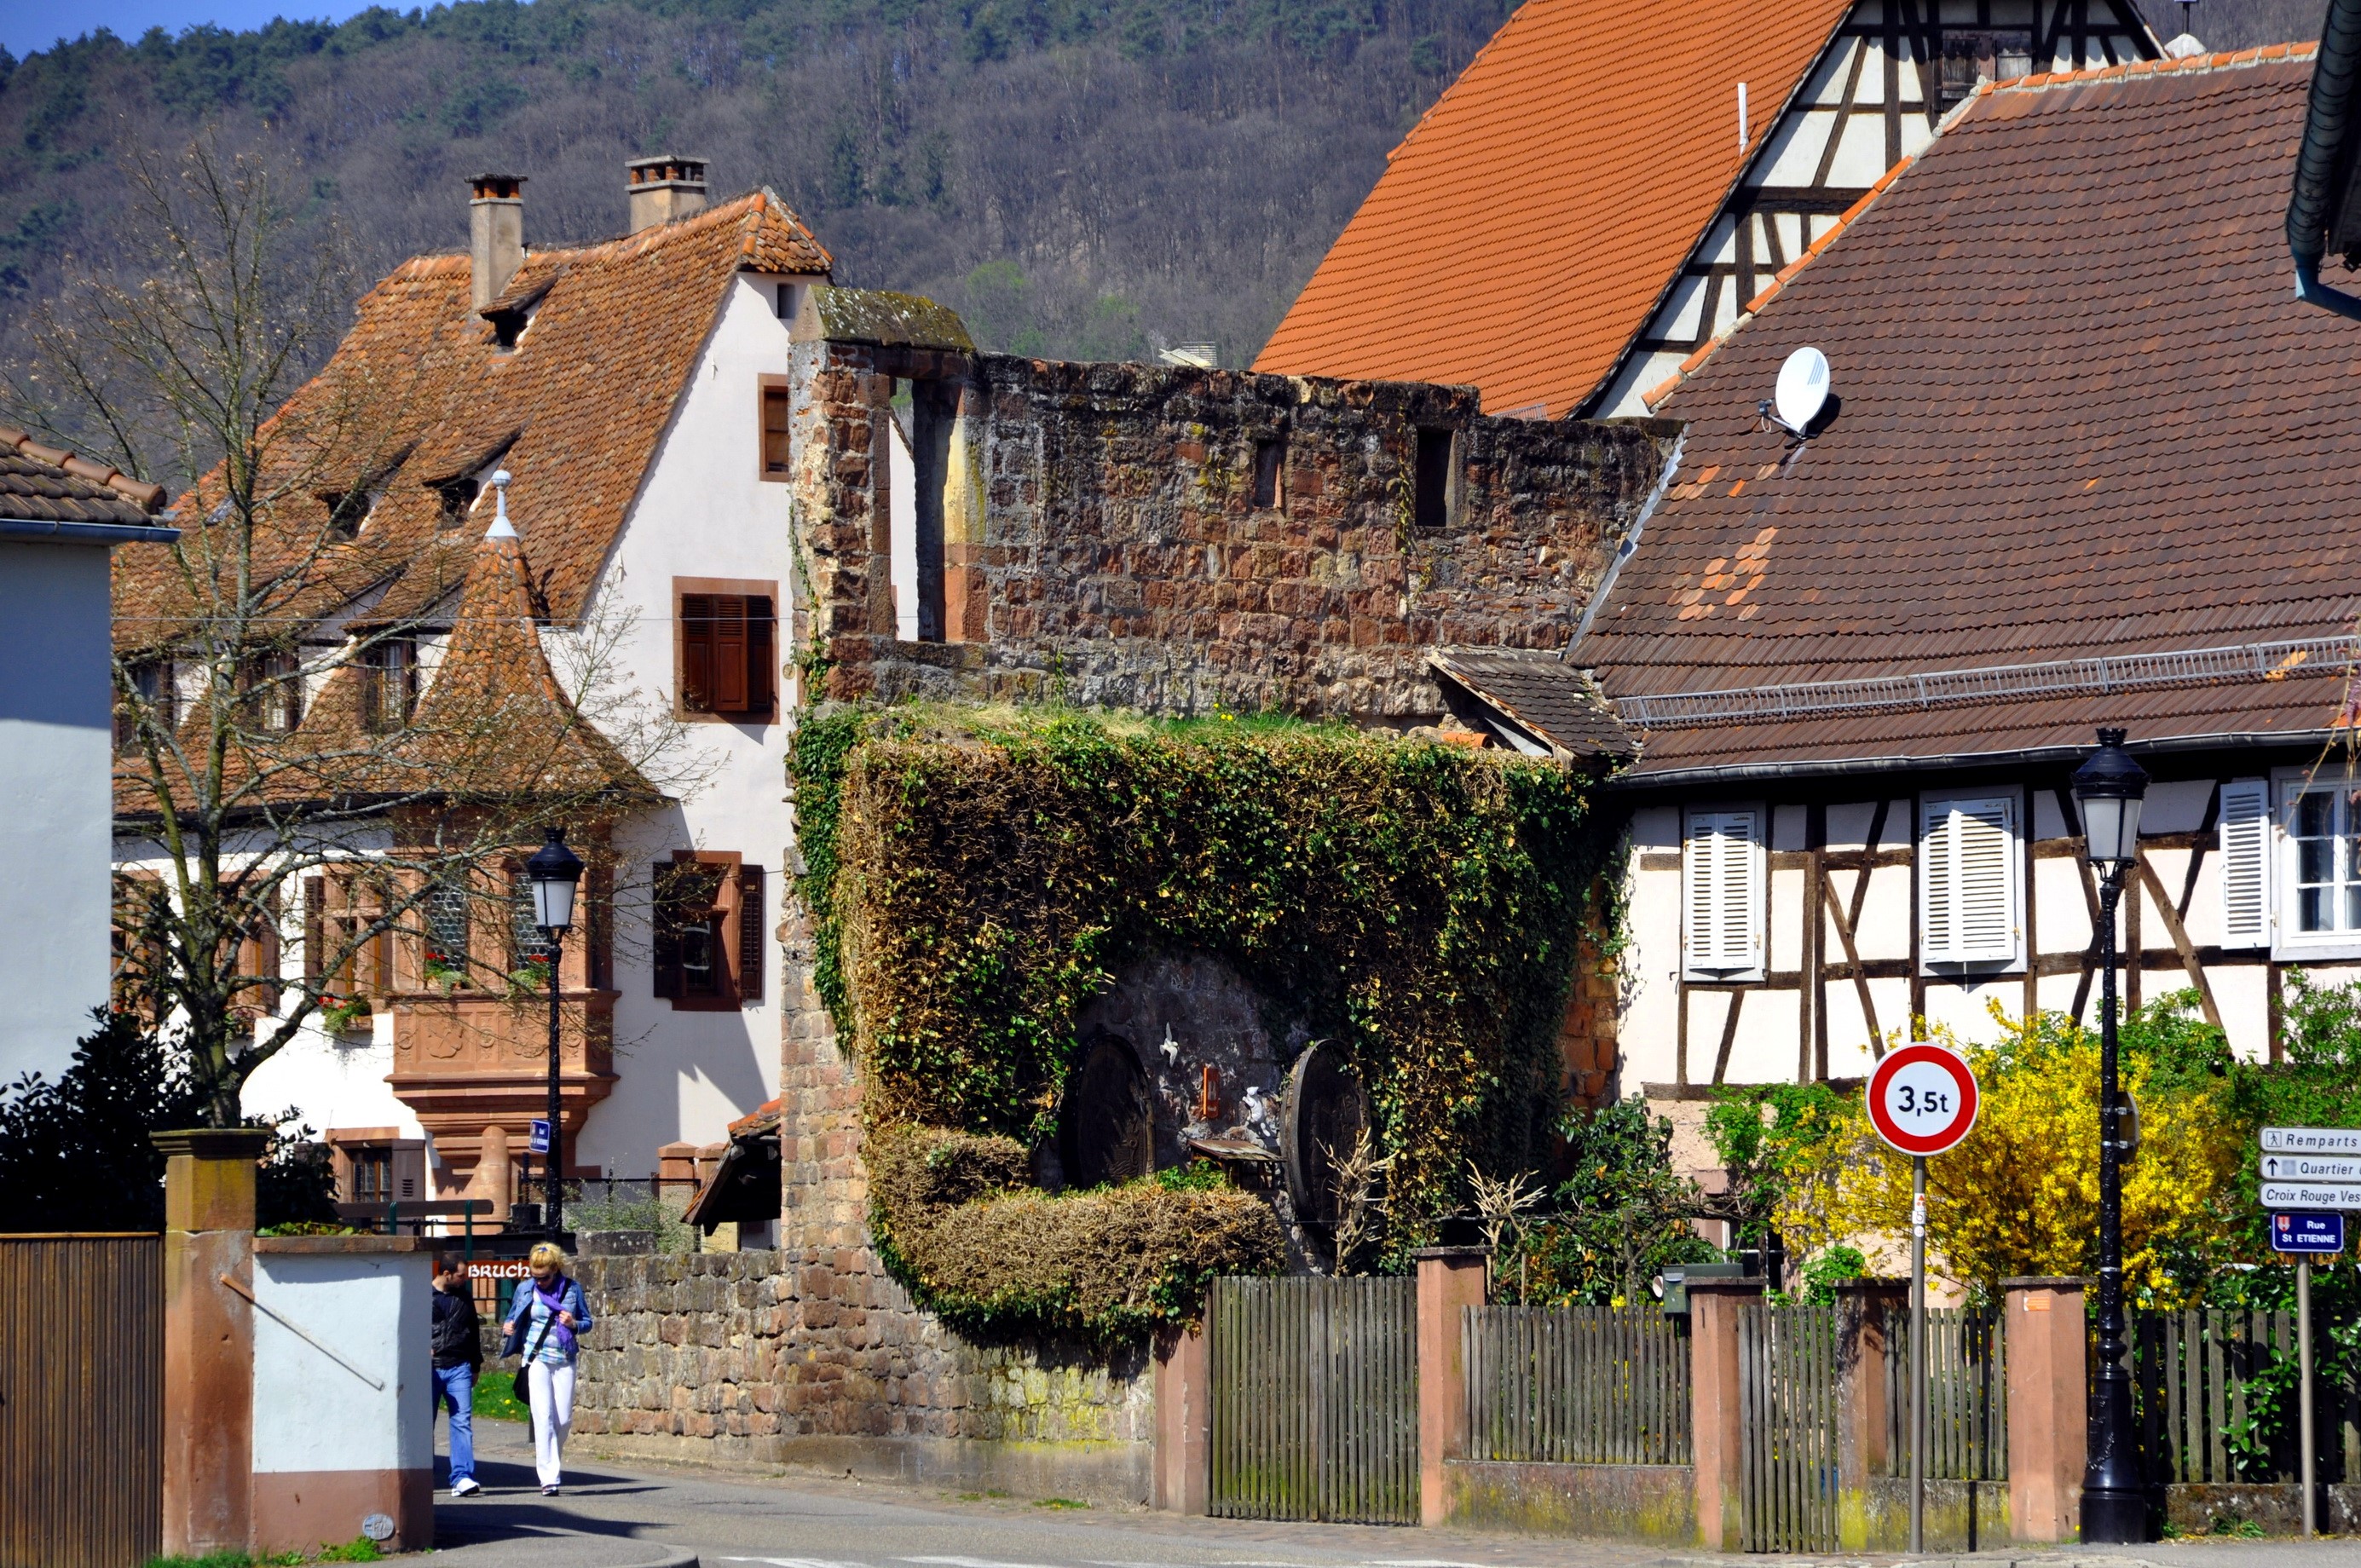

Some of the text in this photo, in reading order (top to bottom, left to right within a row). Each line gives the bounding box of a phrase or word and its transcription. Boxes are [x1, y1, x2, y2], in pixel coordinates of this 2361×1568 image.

[1898, 1086, 1948, 1116] 3,5t
[2286, 1133, 2358, 1149] Remparts
[2300, 1162, 2353, 1175] Quartier
[2266, 1189, 2360, 1205] Croix Rouge Ves
[2306, 1220, 2326, 1230] Rue
[2282, 1233, 2336, 1243] St ETIENNE
